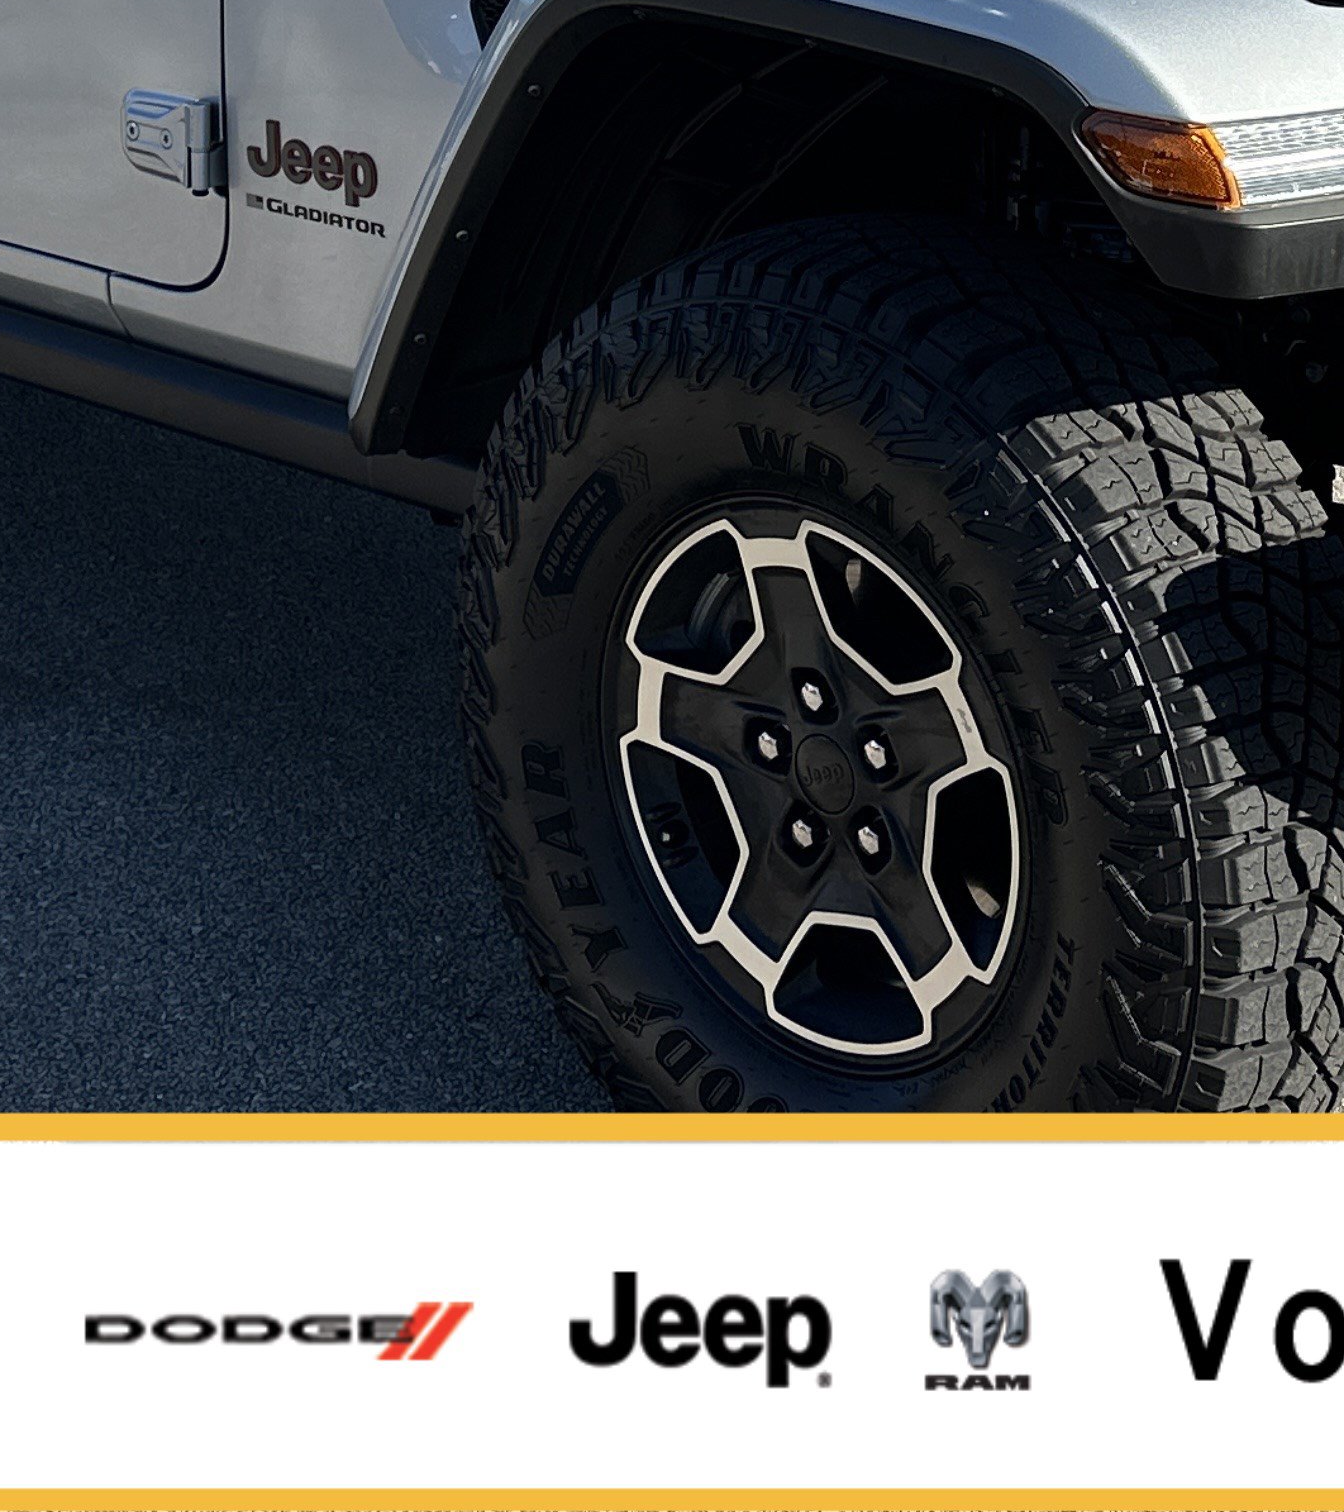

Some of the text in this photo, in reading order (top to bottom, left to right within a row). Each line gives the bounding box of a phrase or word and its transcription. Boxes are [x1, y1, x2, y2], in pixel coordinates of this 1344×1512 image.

[247, 119, 379, 208] Jeep
[266, 197, 386, 238] GLADIATOR
[540, 480, 608, 583] DURAWALL
[802, 761, 846, 787] Jeep
